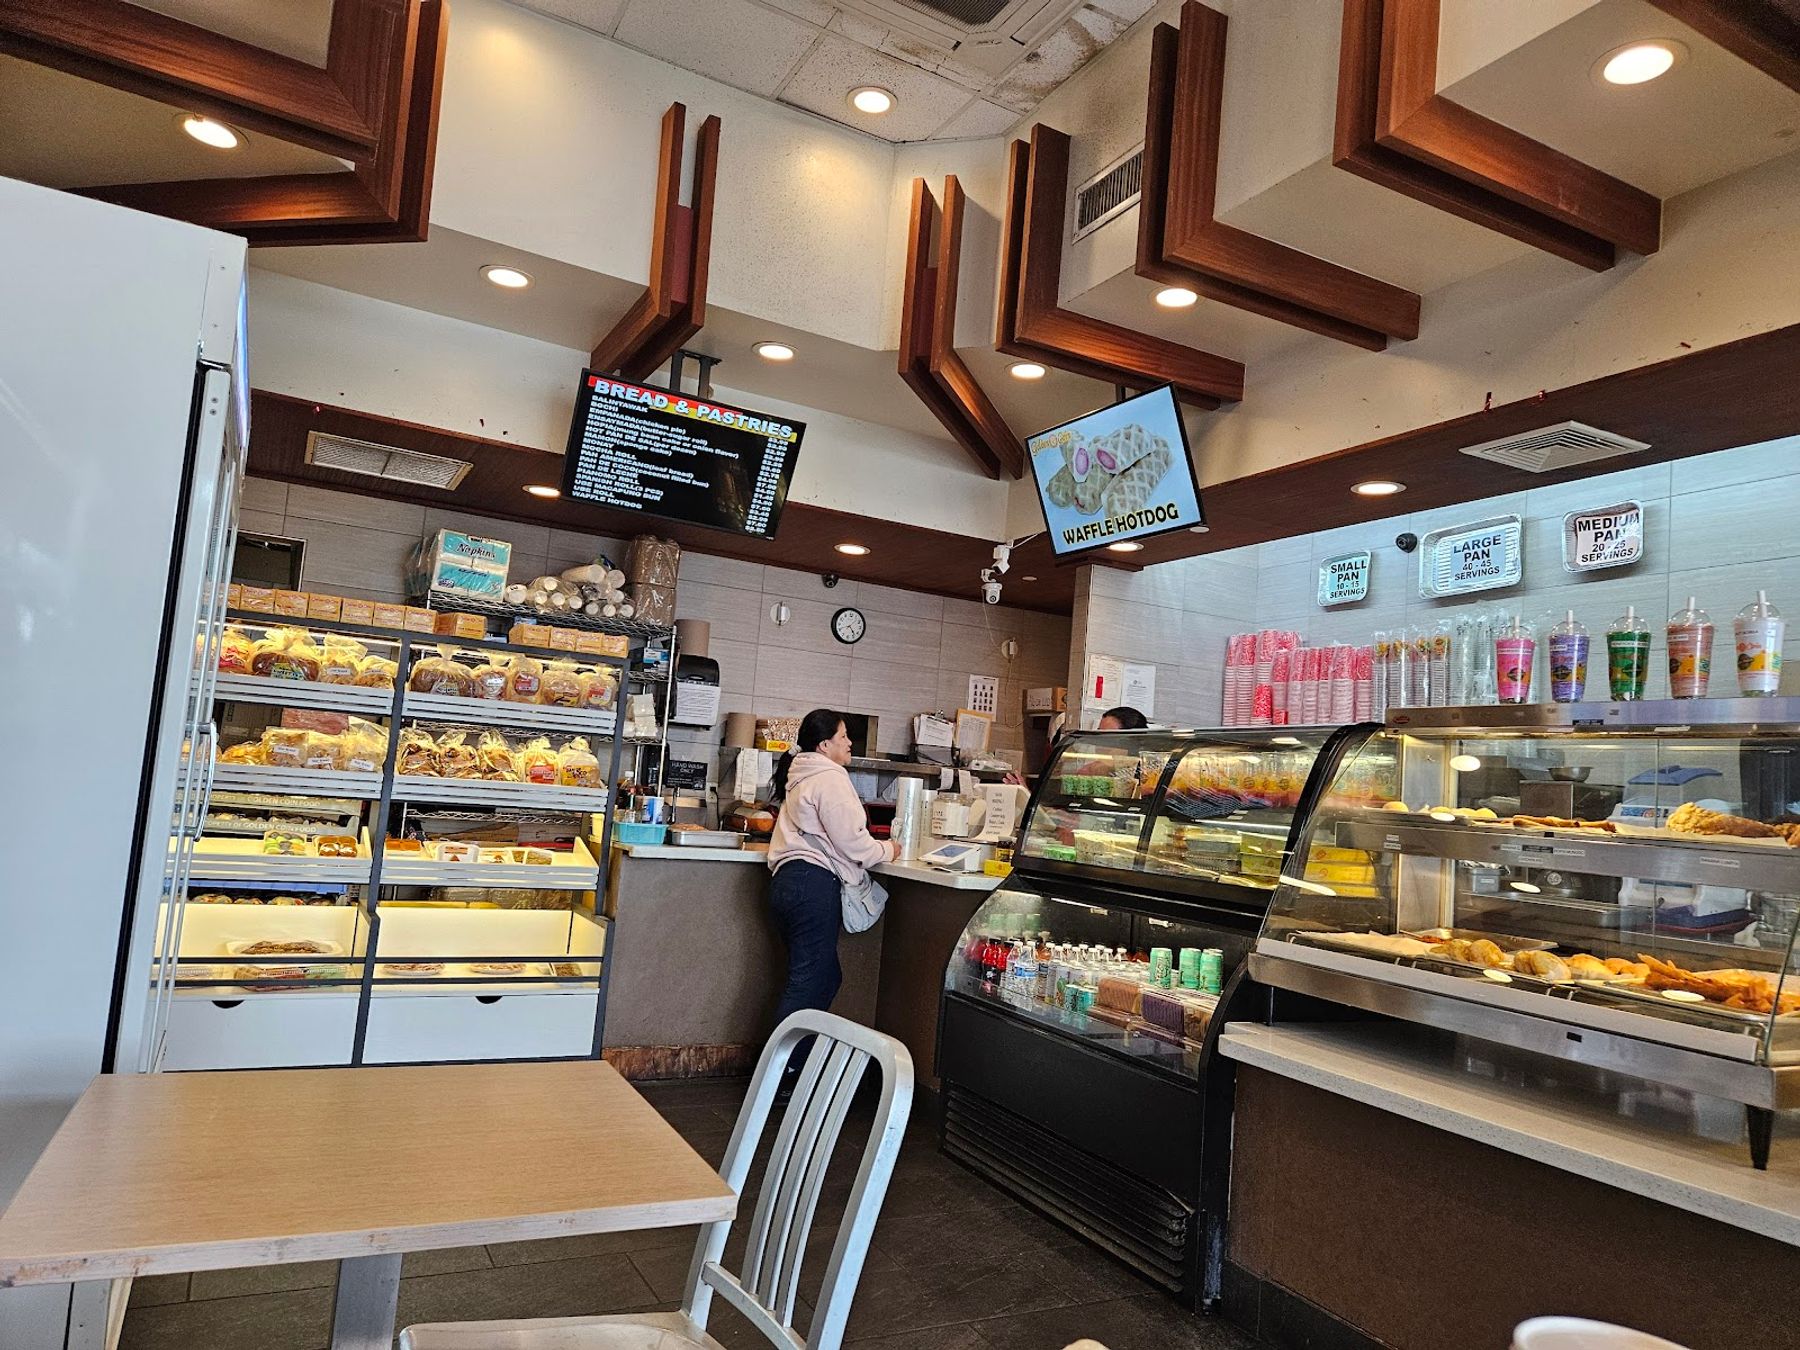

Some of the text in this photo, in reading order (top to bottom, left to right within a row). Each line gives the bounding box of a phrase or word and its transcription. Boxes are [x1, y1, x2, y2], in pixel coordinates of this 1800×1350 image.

[590, 400, 618, 412] BOCHI
[591, 394, 648, 412] BALINTAWAK
[594, 380, 793, 438] BREAD & PASTRIES
[585, 425, 604, 434] HOT
[605, 429, 623, 439] PAN
[582, 437, 614, 448] MONAY
[691, 443, 714, 453] onion
[579, 454, 596, 463] PAN
[580, 448, 598, 457] PAN
[581, 443, 613, 454] MOCHA
[615, 450, 637, 460] ROLL
[578, 460, 595, 469] PAN
[610, 468, 638, 478] LECHE
[575, 472, 612, 485] SPANISH
[617, 475, 640, 485] ROLL
[573, 484, 591, 493] UBE
[592, 488, 615, 498] ROLL
[574, 477, 592, 486] UBE
[593, 482, 641, 497] MACAPUNO
[642, 492, 660, 501] BUN
[571, 489, 605, 501] WAFFLE
[607, 497, 642, 509] HOTDOG
[1063, 503, 1179, 544] WAFFLE HOTDOG
[1578, 513, 1640, 532] MEDIUM
[1594, 529, 1627, 543] PAN
[457, 543, 496, 560] Napkins
[1453, 535, 1501, 554] LARGE
[1592, 543, 1604, 553] 20
[1614, 540, 1625, 550] 25
[1464, 549, 1490, 563] PAN
[1581, 548, 1634, 563] SERVINGS
[1330, 560, 1367, 573] SMALL
[1463, 562, 1474, 571] 40
[1481, 560, 1492, 569] 45
[1337, 571, 1359, 582] PAN
[1455, 566, 1500, 581] SERVINGS
[1330, 587, 1365, 599] SERVINGS
[1336, 582, 1345, 590] 10
[243, 822, 275, 830] GOLDEN
